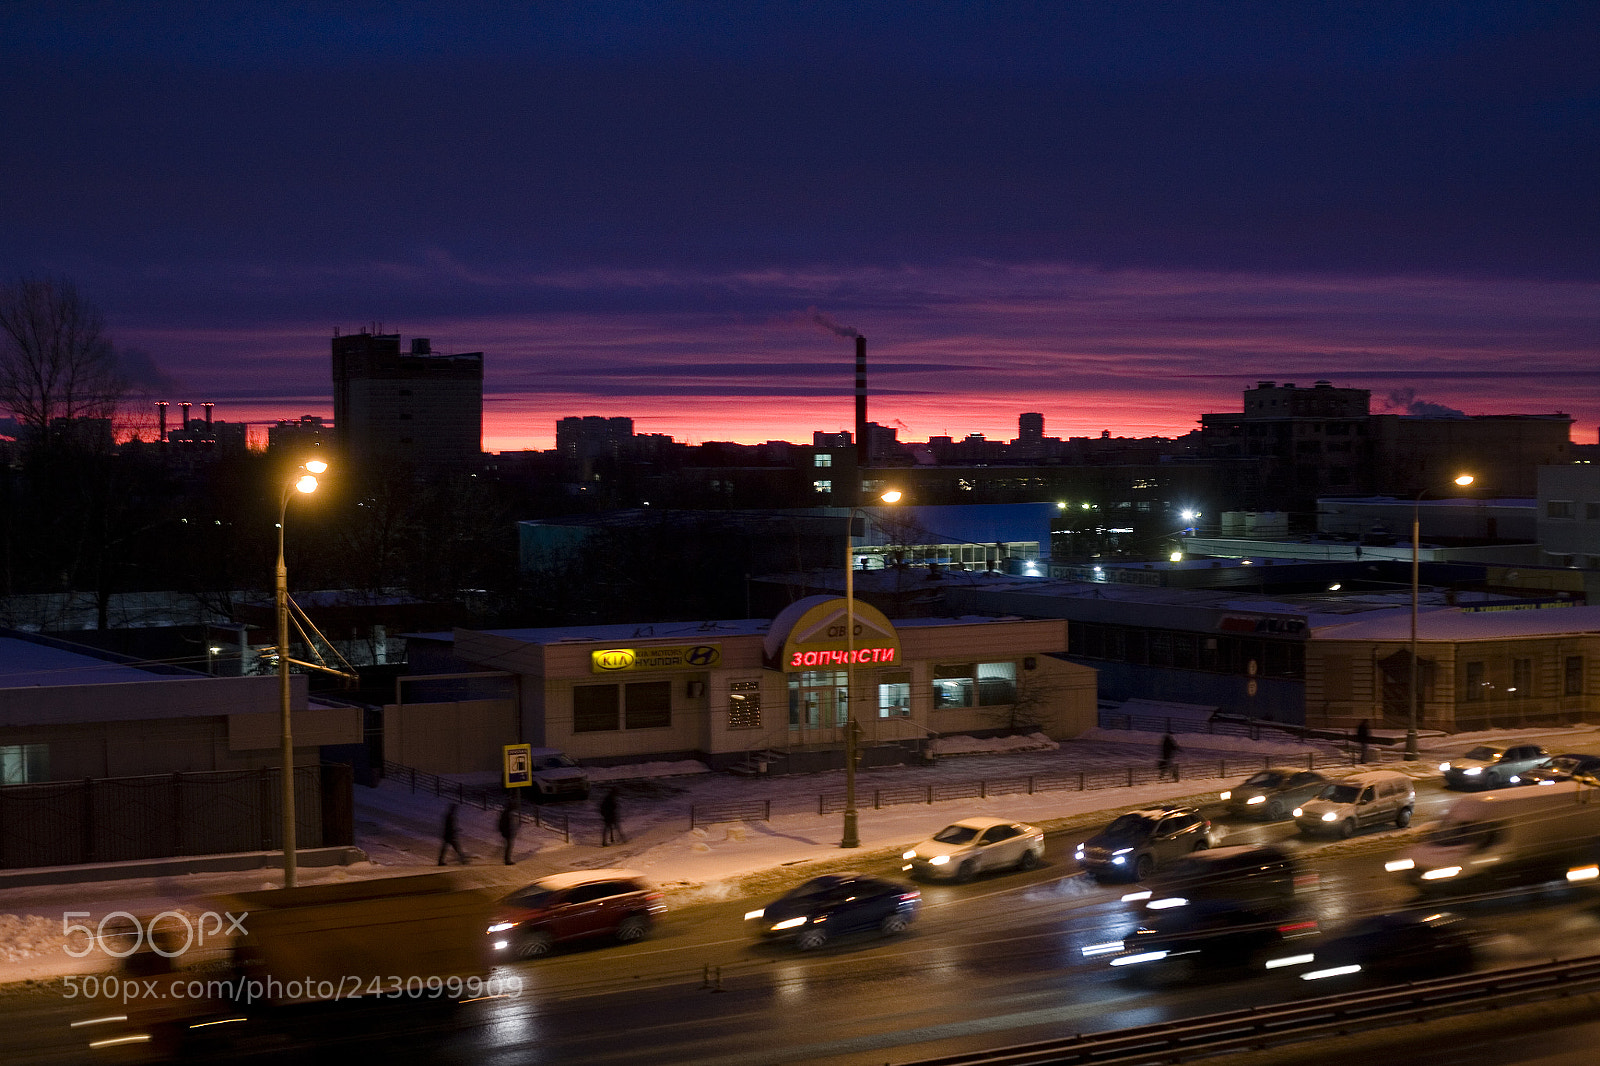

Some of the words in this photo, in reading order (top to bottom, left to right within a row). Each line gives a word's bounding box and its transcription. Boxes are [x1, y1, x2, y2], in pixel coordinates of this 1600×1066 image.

[827, 625, 863, 638] аво
[603, 655, 628, 666] KIA
[635, 657, 683, 666] HYUNDAI
